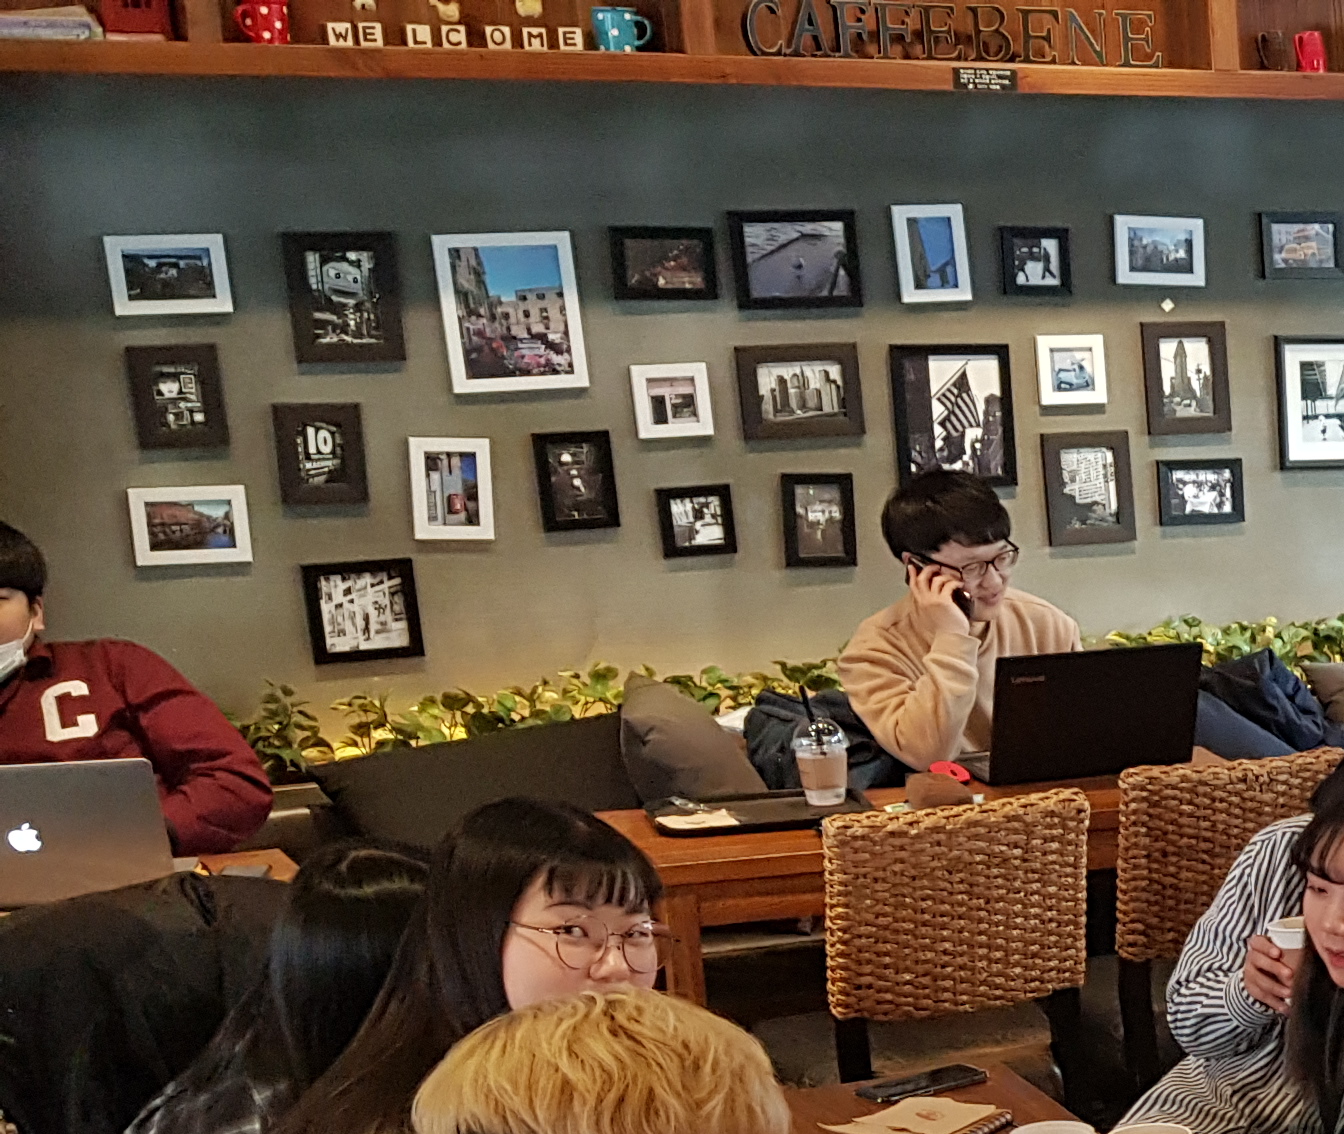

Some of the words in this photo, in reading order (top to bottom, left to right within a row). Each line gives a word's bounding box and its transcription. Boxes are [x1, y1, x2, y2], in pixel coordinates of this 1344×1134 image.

[331, 25, 579, 48] WELCOME
[306, 425, 333, 454] 10
[39, 680, 99, 743] C
